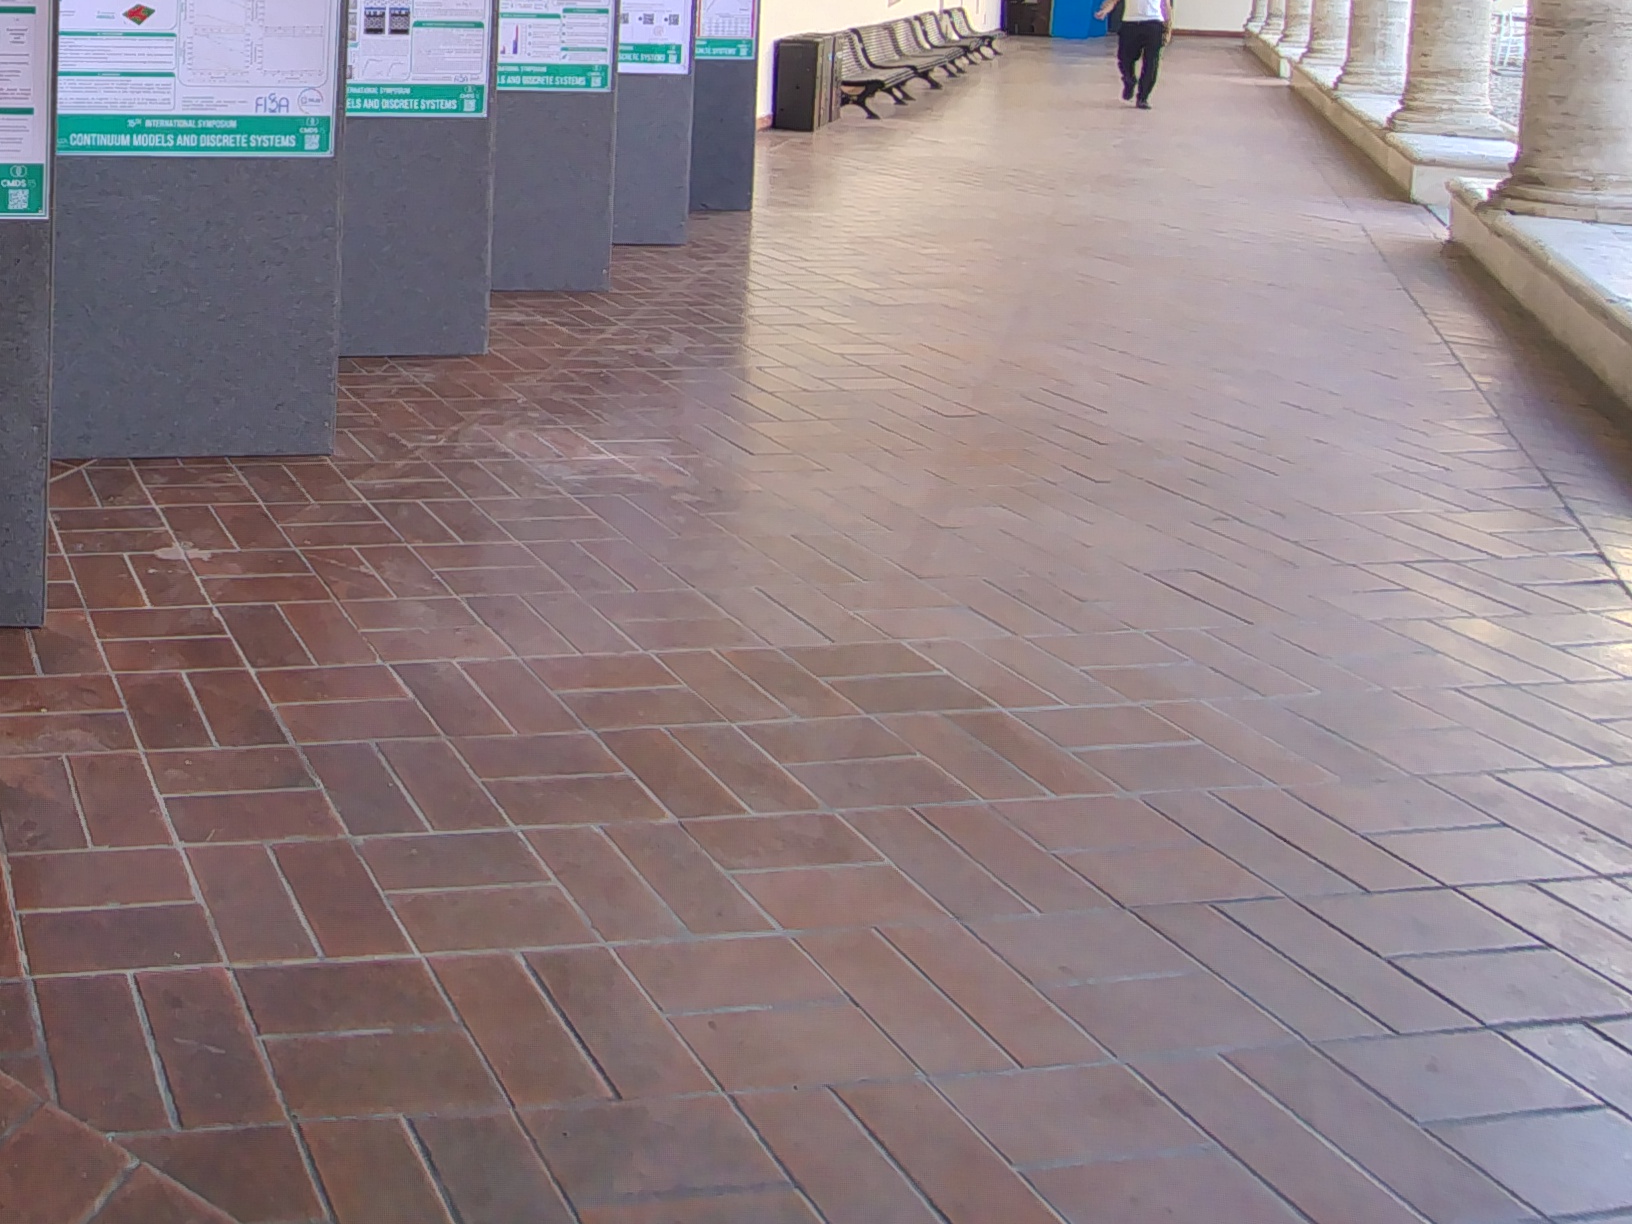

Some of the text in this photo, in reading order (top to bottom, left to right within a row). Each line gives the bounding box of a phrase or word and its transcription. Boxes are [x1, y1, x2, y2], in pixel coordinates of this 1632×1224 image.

[363, 99, 379, 108] AND
[381, 99, 418, 109] DISCRETE
[420, 100, 457, 109] SYSTEMS
[145, 119, 196, 128] INTERNATIONAL
[198, 120, 237, 128] SYMPOSIUM
[70, 133, 296, 147] CONTINUUM MODELS AND DISCRETE SYSTEMS
